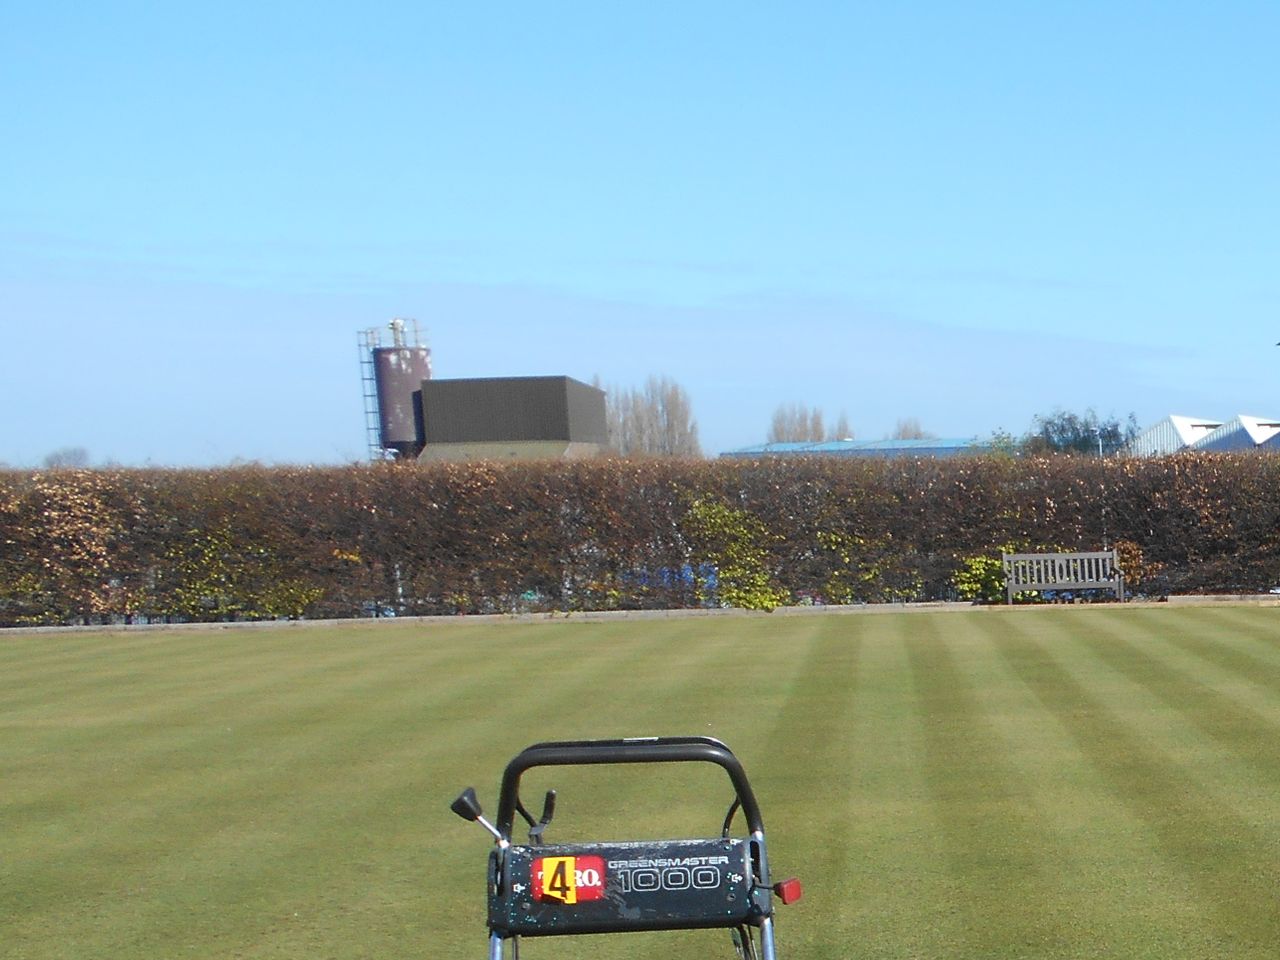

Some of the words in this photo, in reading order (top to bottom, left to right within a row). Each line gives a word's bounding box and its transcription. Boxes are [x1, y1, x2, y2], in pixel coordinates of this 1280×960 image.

[608, 856, 729, 869] GREENSMASTER
[548, 860, 571, 898] 4
[618, 866, 721, 892] 1000
